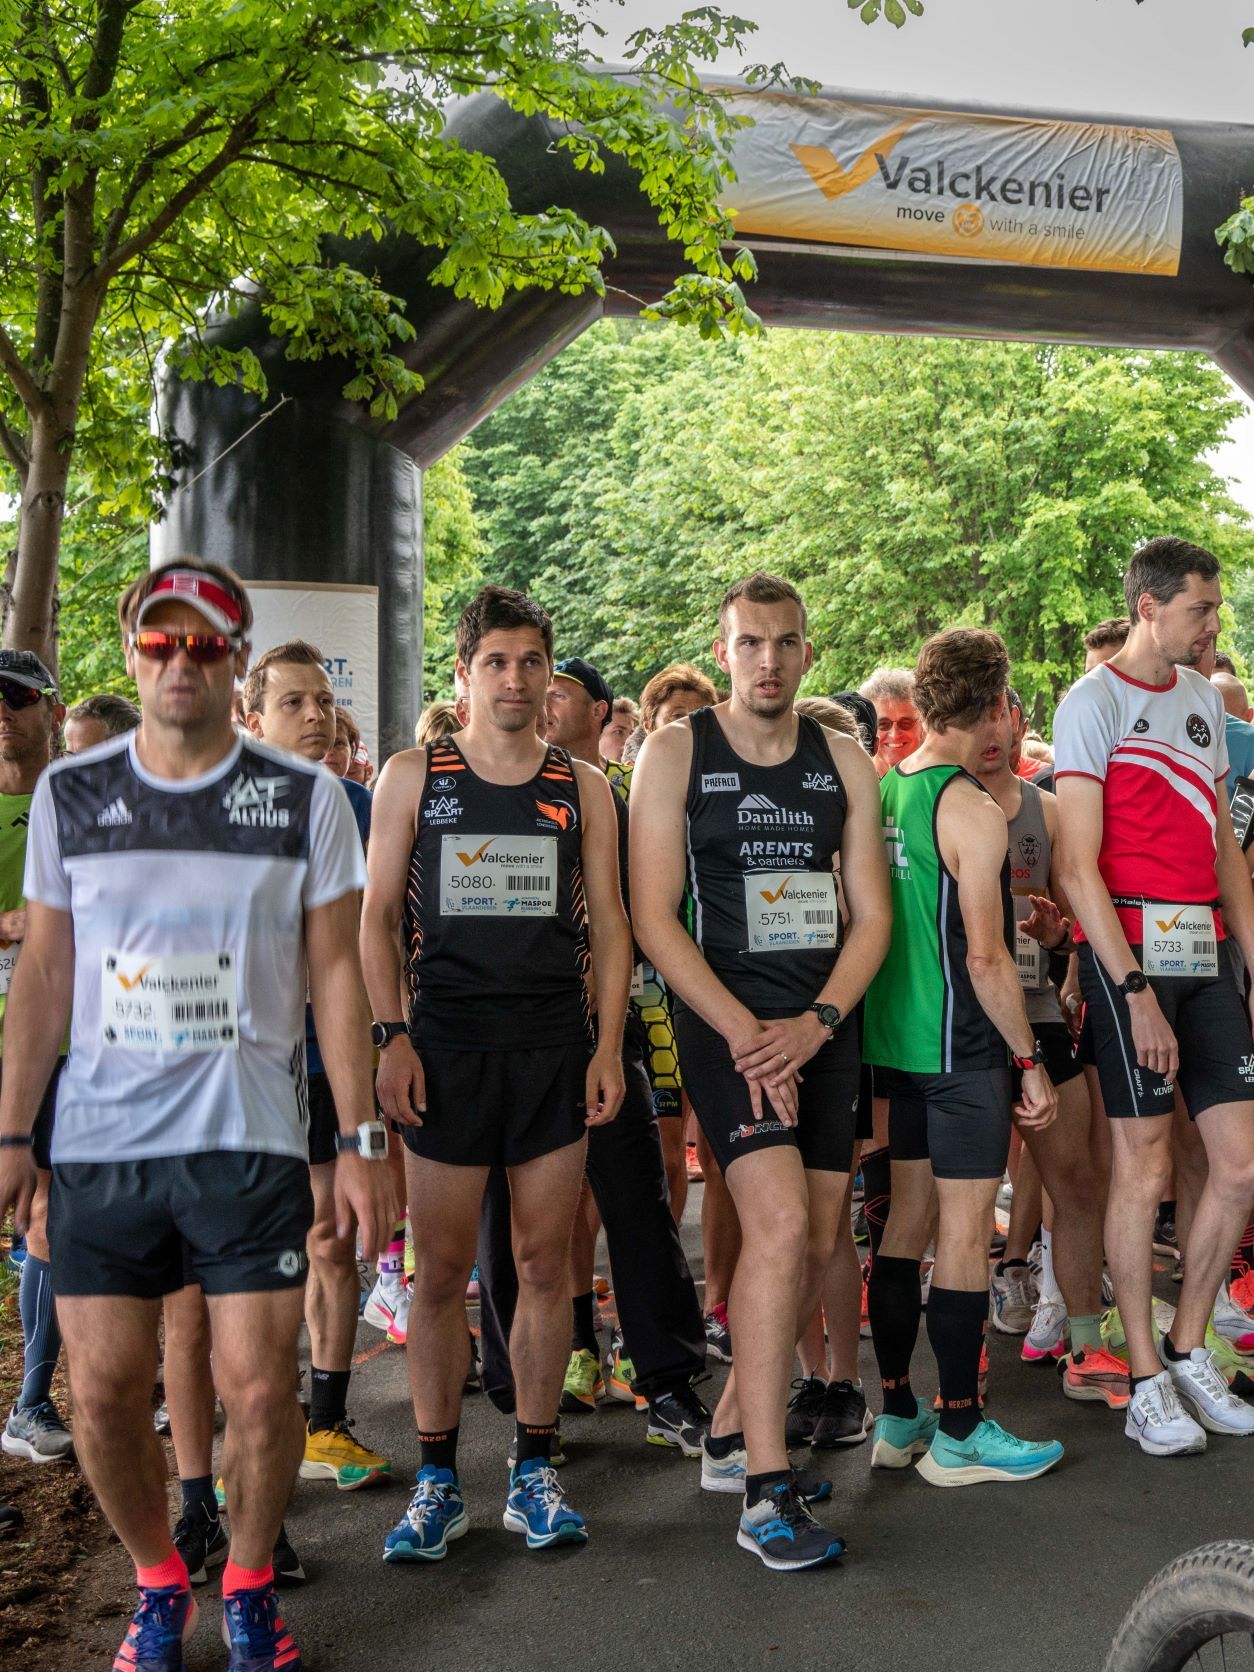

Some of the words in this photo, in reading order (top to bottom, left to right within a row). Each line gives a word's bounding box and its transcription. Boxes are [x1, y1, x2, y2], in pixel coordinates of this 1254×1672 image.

[873, 152, 1112, 213] Valckenier
[896, 206, 945, 223] move
[990, 218, 1023, 234] with
[1028, 224, 1039, 235] a
[1044, 225, 1085, 240] smile
[325, 658, 353, 676] RT.
[331, 677, 353, 688] REN
[737, 808, 815, 826] Danilith
[738, 841, 814, 858] ARENTS
[478, 852, 545, 864] Valckenier
[746, 856, 757, 867] &
[758, 857, 806, 867] partners
[1010, 868, 1031, 879] eos
[780, 888, 828, 900] Valckenier
[461, 897, 497, 906] SPORT.
[521, 900, 552, 908] MASPOE
[768, 931, 800, 941] SPORT.
[1160, 960, 1187, 968] SPORT.
